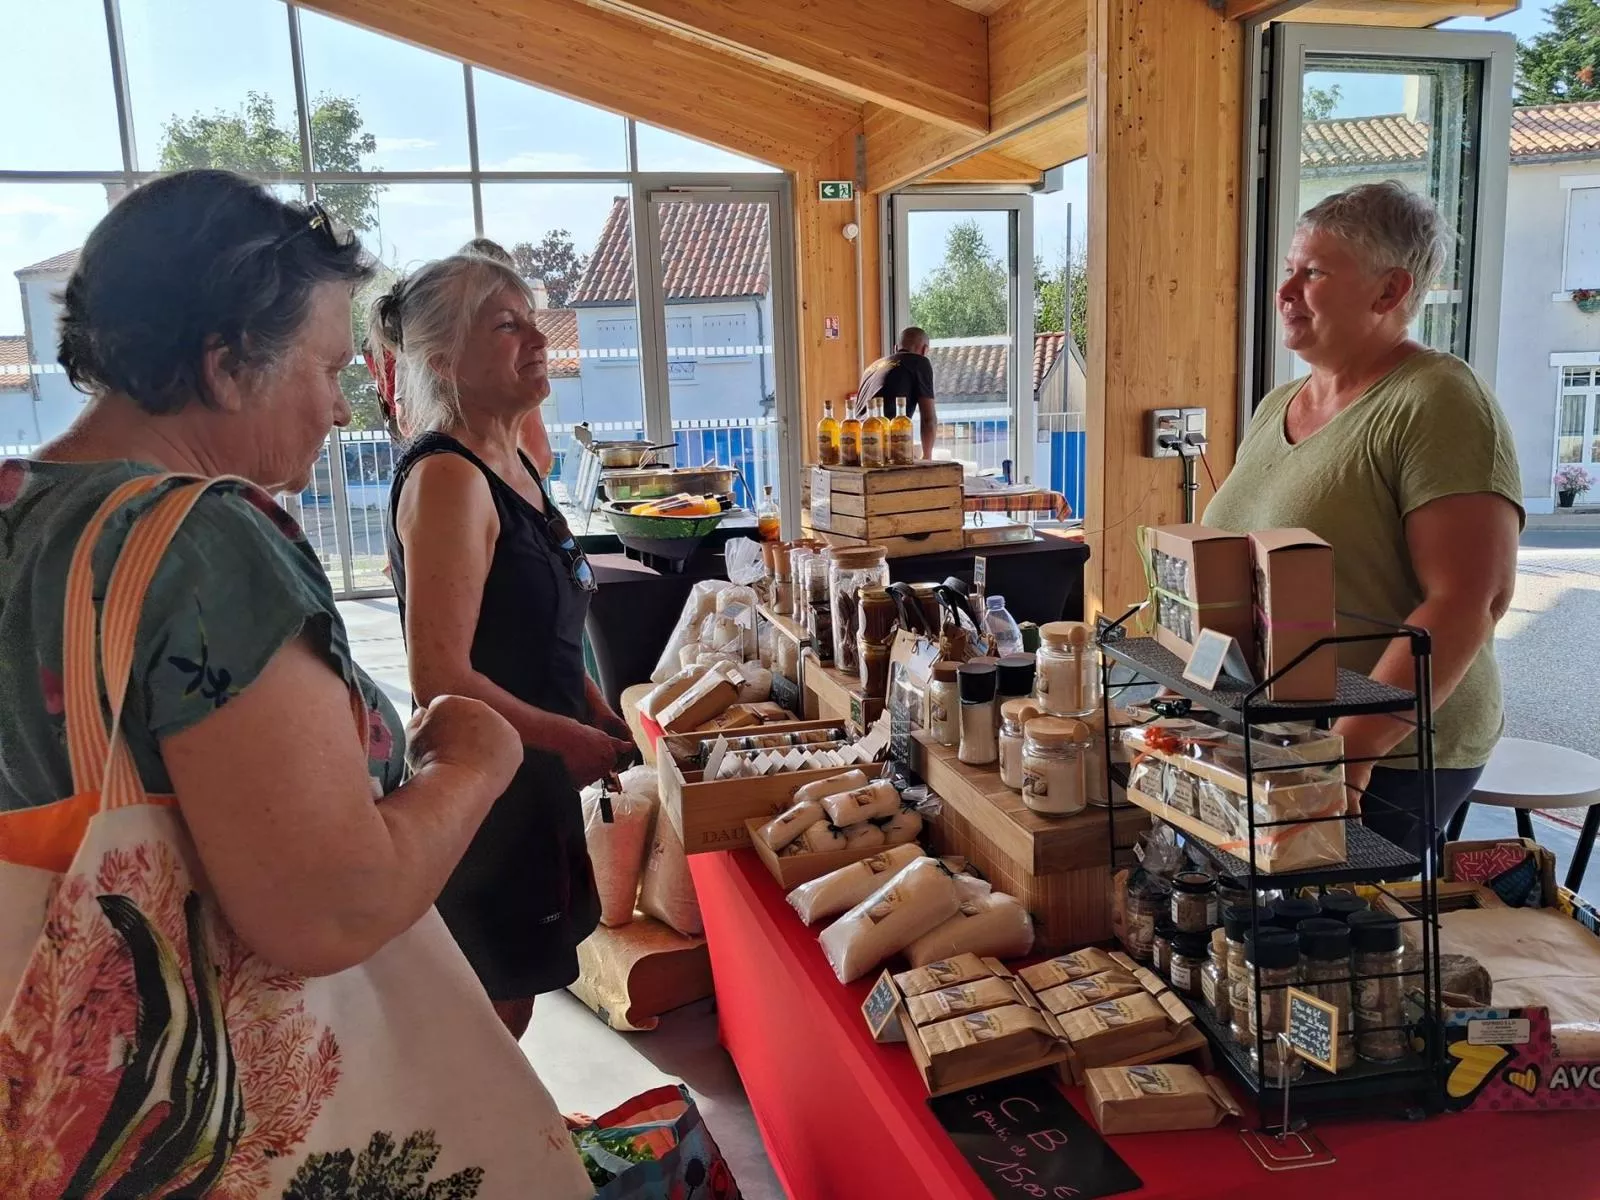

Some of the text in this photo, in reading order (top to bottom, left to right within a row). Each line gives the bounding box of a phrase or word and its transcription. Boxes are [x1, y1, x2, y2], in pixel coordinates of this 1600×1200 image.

[701, 825, 750, 845] DAU
[1000, 1097, 1068, 1151] C B
